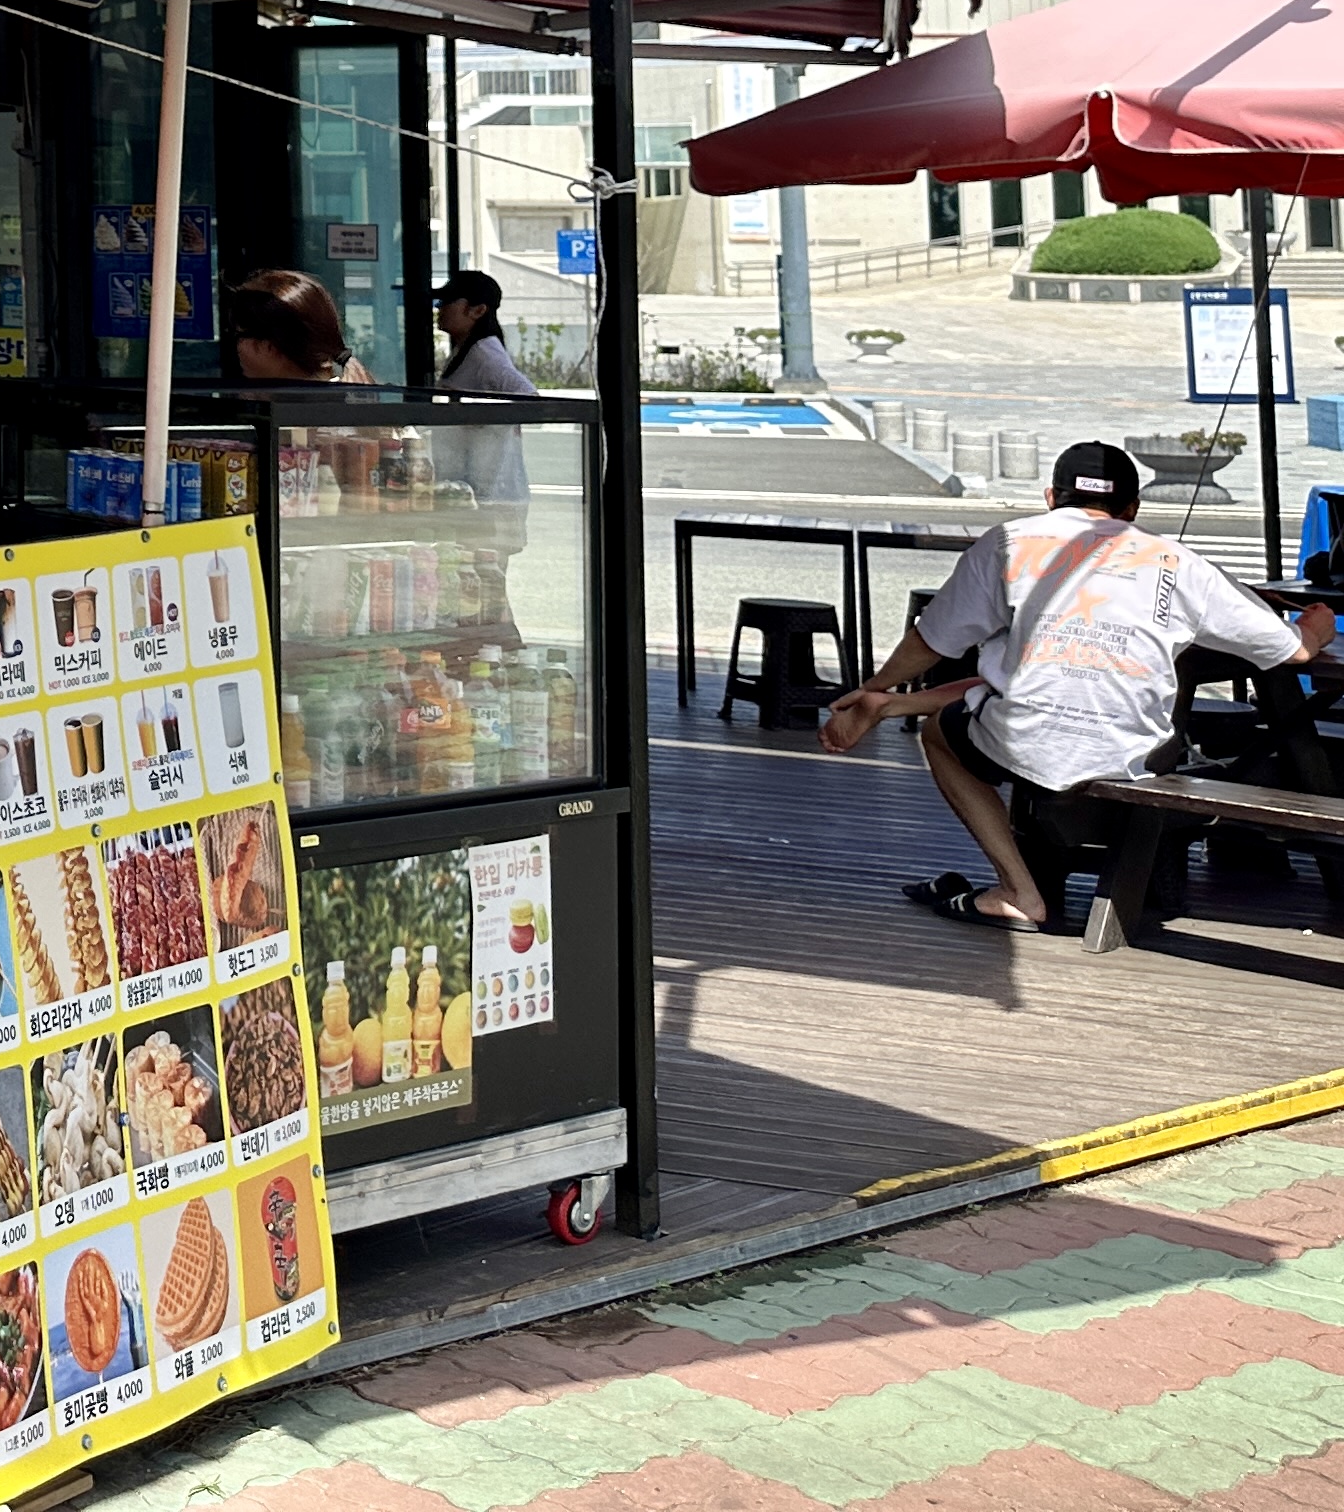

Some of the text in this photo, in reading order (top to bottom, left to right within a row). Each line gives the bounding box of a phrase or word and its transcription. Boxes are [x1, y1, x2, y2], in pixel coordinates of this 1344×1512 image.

[134, 637, 169, 661] 에이드
[207, 625, 239, 649] 냉율무
[54, 648, 102, 675] 믹스커피
[143, 661, 162, 674] 4,000
[215, 647, 235, 661] 4,000
[228, 750, 249, 772] 식혜
[148, 764, 184, 791] 슬러시
[232, 773, 250, 786] 4,000
[558, 800, 594, 817] GRAND
[474, 855, 543, 888] 한입 마카롱
[227, 942, 279, 979] 핫도그 3,500
[178, 967, 203, 990] 4,000
[29, 994, 112, 1039] 회오리감자 4,000
[362, 1090, 401, 1117] 넣지않은
[240, 1119, 301, 1161] 번데기 3,000
[135, 1149, 225, 1196] 국화빵 4,000
[54, 1187, 115, 1228] 오뎅 1,000
[1, 1223, 27, 1248] 4,000
[260, 1301, 316, 1344] 컵라면 2,500
[174, 1340, 224, 1381] 와플 3,000
[63, 1378, 144, 1428] 호미곶빵 4,000
[20, 1420, 44, 1448] 5,000
